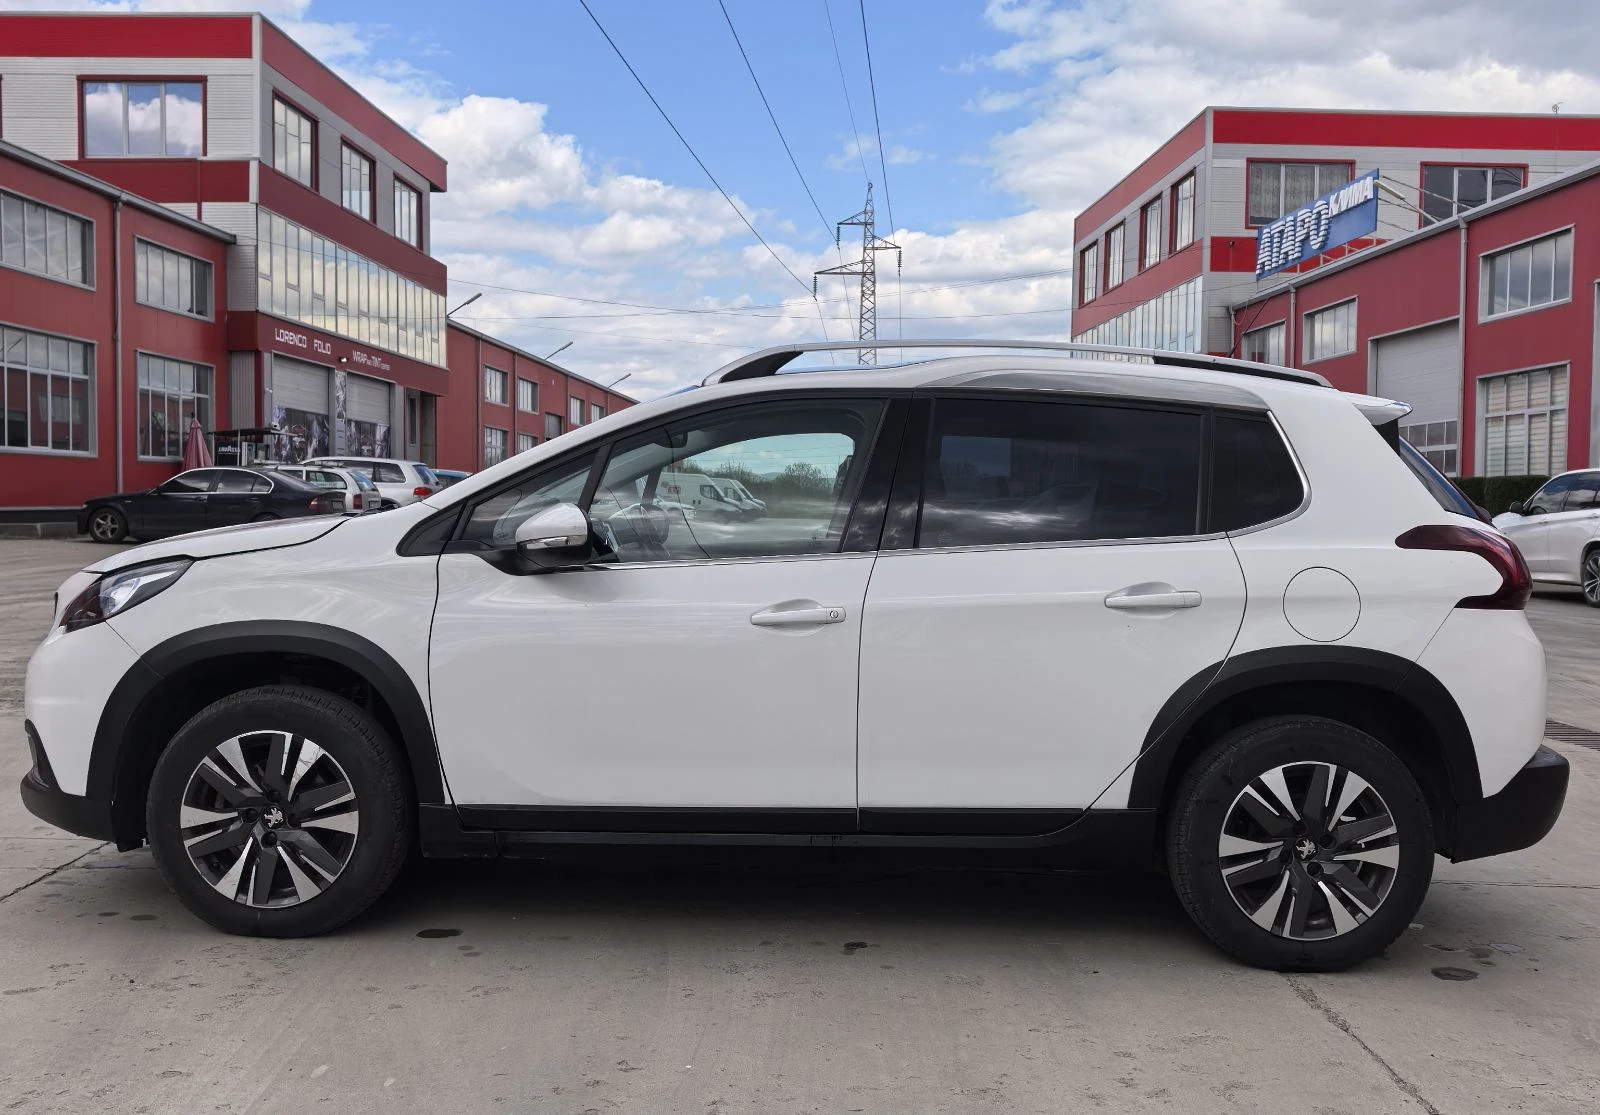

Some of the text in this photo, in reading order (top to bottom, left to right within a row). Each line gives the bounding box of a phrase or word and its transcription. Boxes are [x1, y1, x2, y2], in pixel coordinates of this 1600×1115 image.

[1256, 176, 1374, 274] АТАРО КЛИМА
[275, 328, 331, 355] LORENCO FOLIO
[353, 350, 367, 364] WRAP
